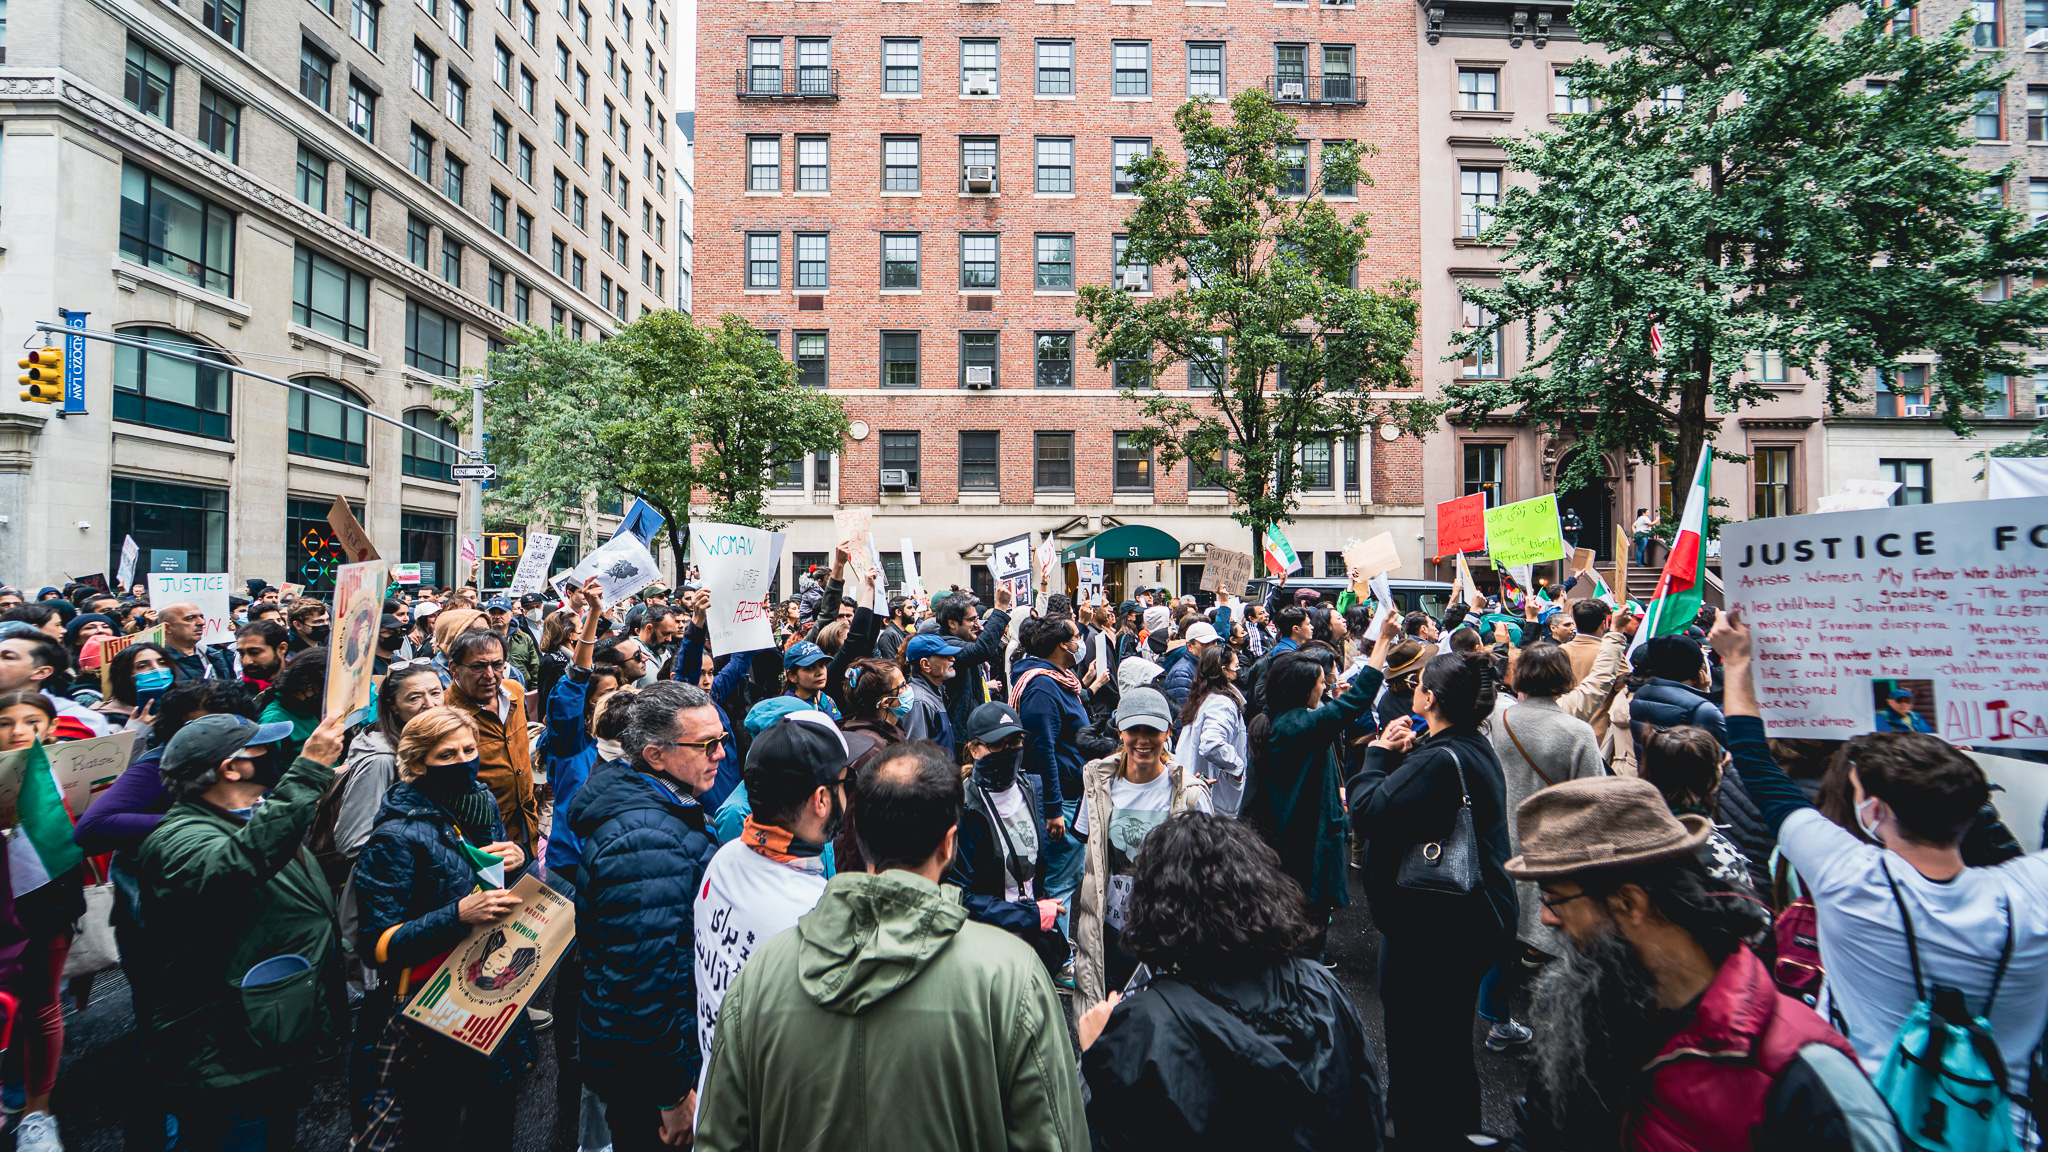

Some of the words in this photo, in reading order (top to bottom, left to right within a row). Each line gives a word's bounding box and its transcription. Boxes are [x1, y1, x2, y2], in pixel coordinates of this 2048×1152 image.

[72, 318, 84, 375] CRDOZO
[72, 377, 83, 401] LAW
[835, 511, 871, 529] SPEAK
[698, 534, 756, 556] WOMAN
[850, 529, 871, 543] OUT
[1128, 546, 1140, 557] 51
[1738, 529, 1938, 568] JUSTICE
[1961, 565, 1990, 580] who
[1993, 564, 2040, 580] didn't
[159, 576, 224, 593] JUSTICE
[1751, 600, 1773, 613] lost
[1776, 596, 1836, 612] childhood
[1879, 586, 1950, 605] goodbye
[1817, 619, 1874, 631] Iranian
[1878, 617, 1950, 634] diaspora
[1793, 635, 1811, 651] go
[1817, 632, 1855, 645] home
[1758, 649, 1803, 662] dreams
[1808, 651, 1829, 664] my
[1876, 645, 1903, 659] left
[1906, 644, 1954, 658] behind
[1760, 666, 1782, 680] life
[1786, 668, 1799, 679] I
[1804, 665, 1838, 678] could
[1843, 665, 1875, 677] have
[1879, 663, 1909, 677] had
[2009, 663, 2041, 675] who
[1761, 683, 1838, 699] imprisoned
[1949, 679, 1988, 692] free
[70, 754, 115, 773] Raise
[523, 905, 550, 925] FREEDOM
[510, 919, 539, 943] WOMAN
[711, 906, 739, 955] برای
